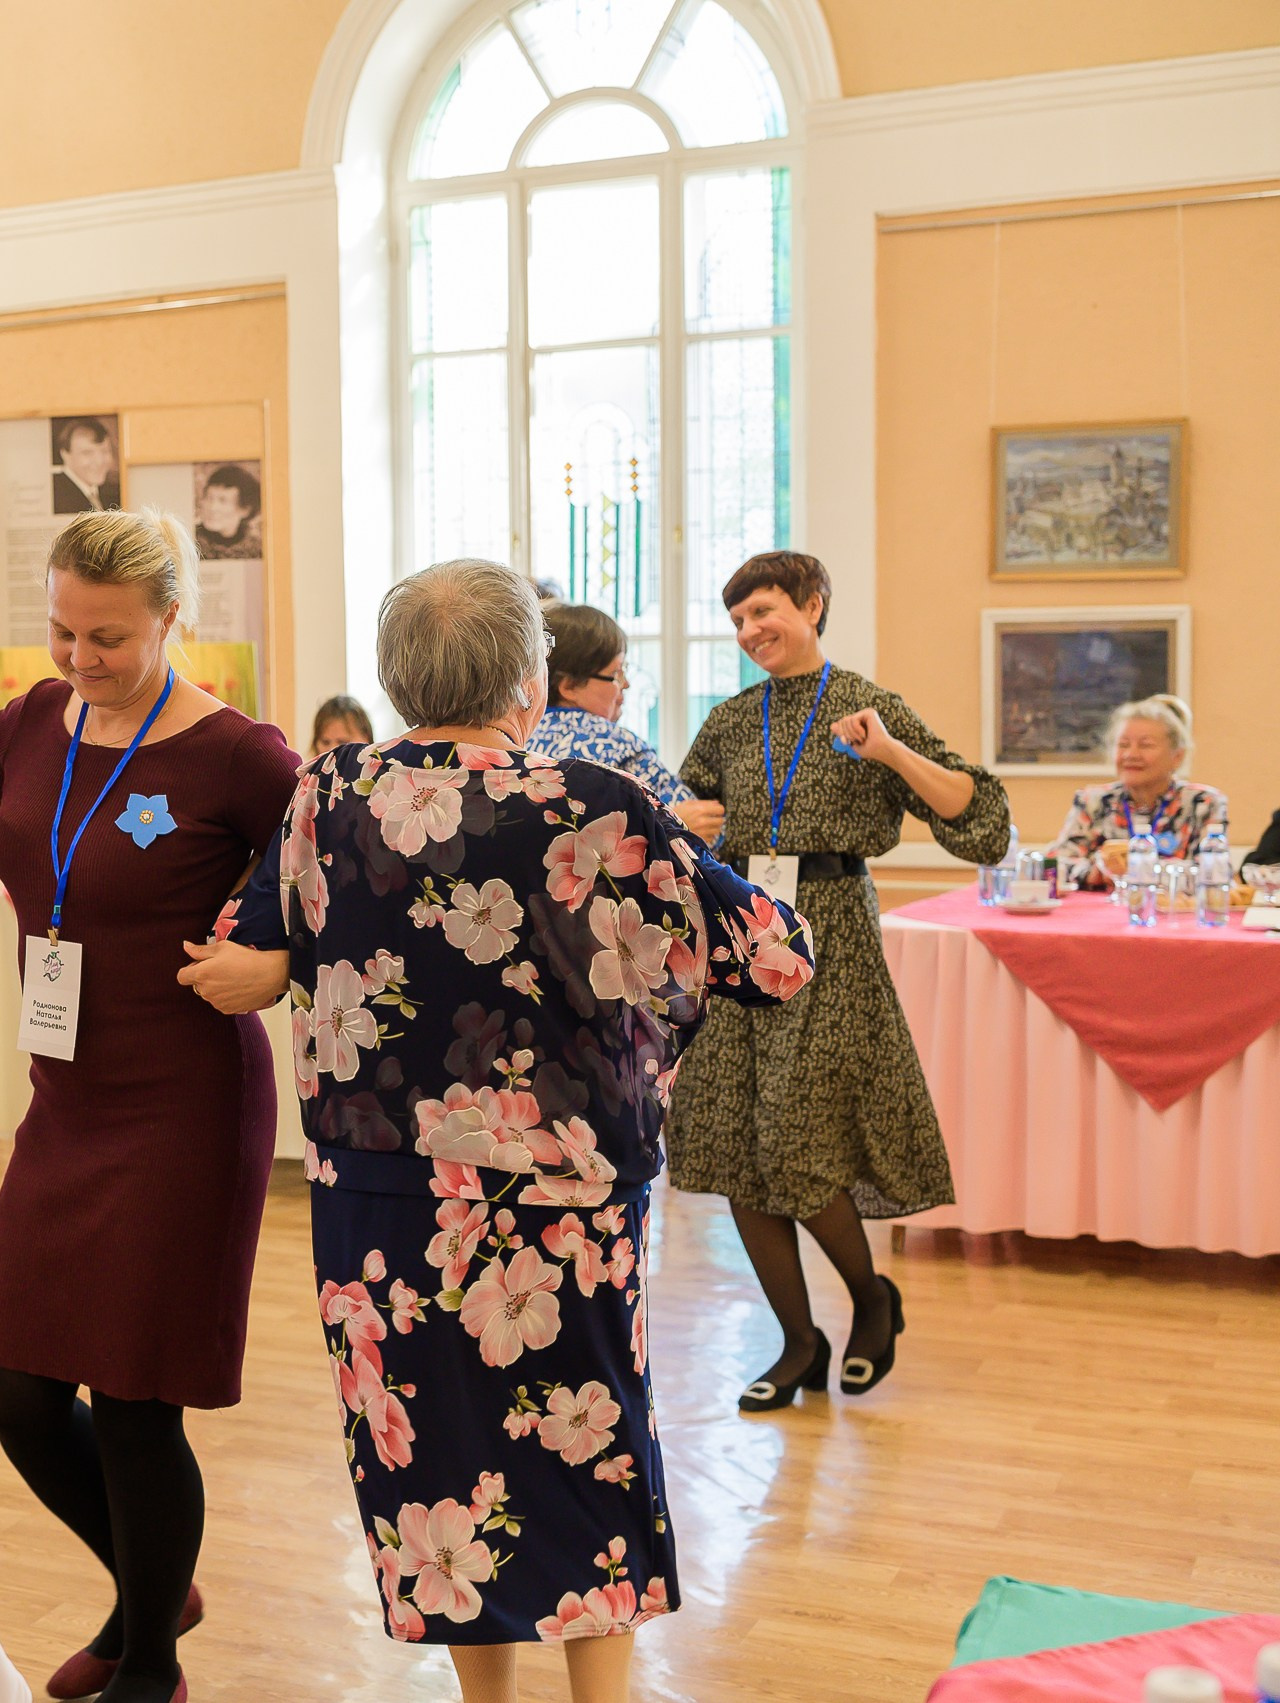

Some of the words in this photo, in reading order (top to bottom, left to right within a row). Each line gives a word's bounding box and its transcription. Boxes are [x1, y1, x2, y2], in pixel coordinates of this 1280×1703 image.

[32, 999, 67, 1012] Родионова
[36, 1010, 62, 1021] Наталья
[29, 1017, 67, 1031] Валерьевна
